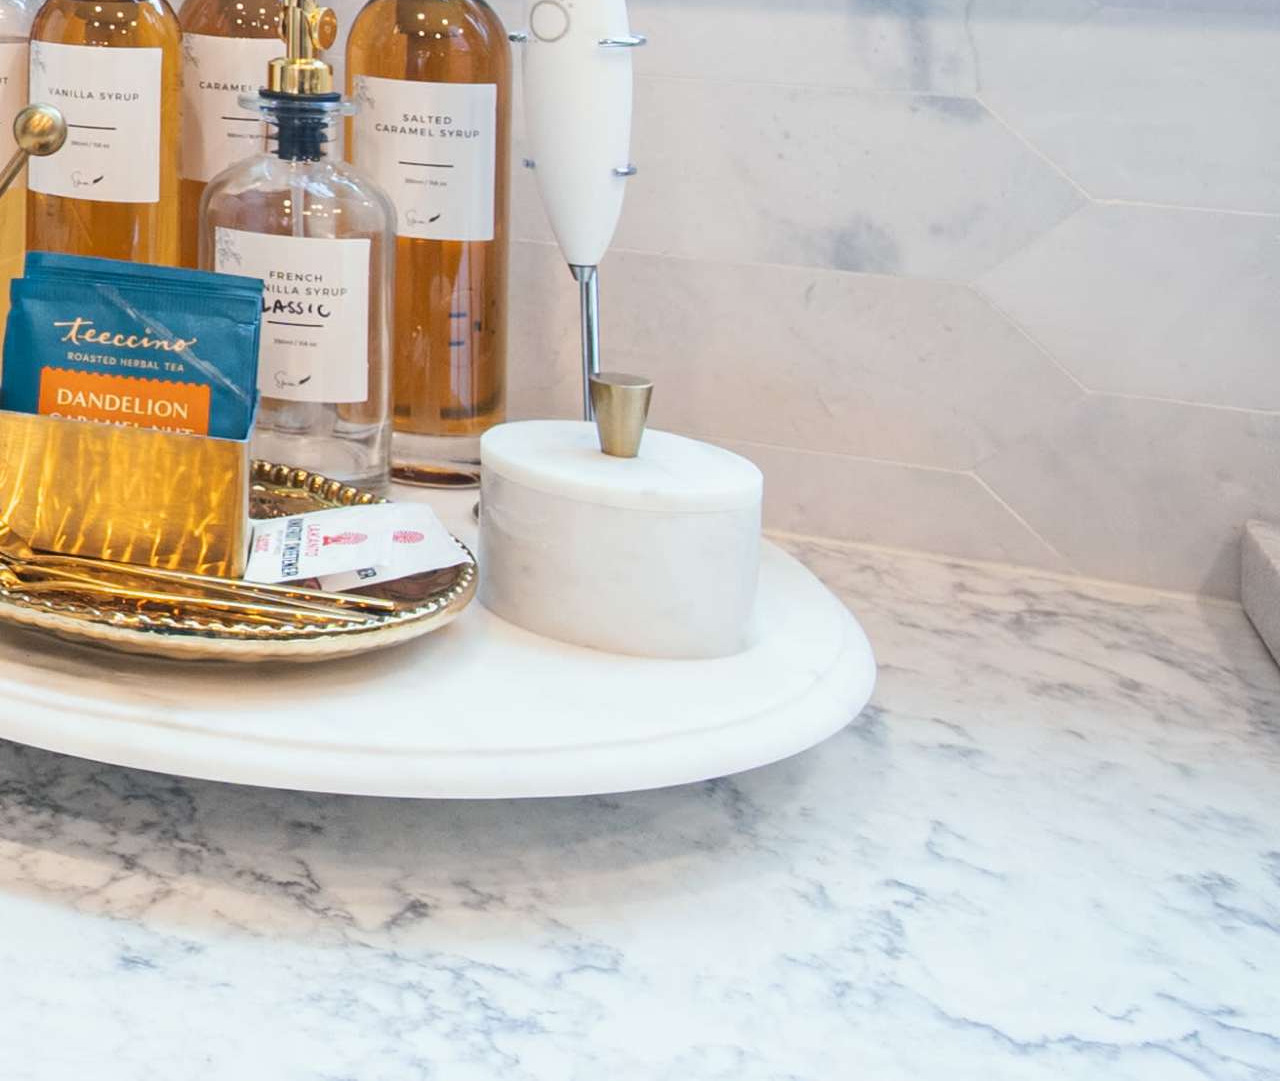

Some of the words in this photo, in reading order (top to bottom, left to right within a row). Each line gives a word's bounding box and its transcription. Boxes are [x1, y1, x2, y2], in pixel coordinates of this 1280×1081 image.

[48, 87, 94, 99] VANILLA
[100, 91, 140, 101] SYRUP
[402, 113, 452, 125] SALTED
[375, 123, 434, 137] CARAMEL
[440, 128, 480, 138] SYRUP
[269, 270, 322, 282] FRENCH
[263, 283, 300, 295] NILLA
[305, 287, 348, 297] SYRUP
[261, 297, 331, 318] LASSIC
[54, 317, 198, 352] teeccino
[67, 351, 117, 366] ROASTED
[120, 358, 160, 370] HERBAL
[164, 362, 185, 372] TEA
[57, 388, 188, 419] DANDELION
